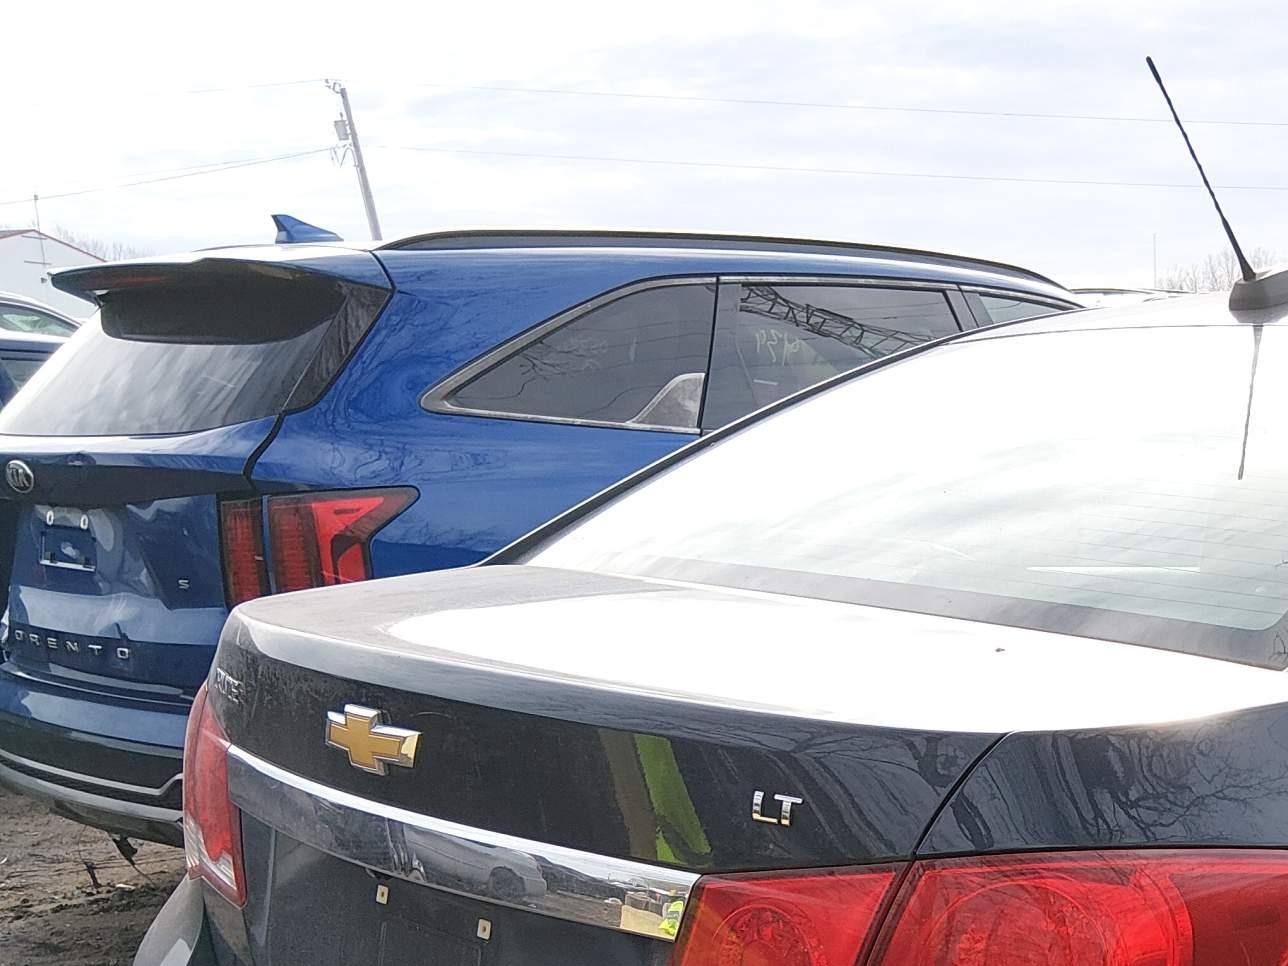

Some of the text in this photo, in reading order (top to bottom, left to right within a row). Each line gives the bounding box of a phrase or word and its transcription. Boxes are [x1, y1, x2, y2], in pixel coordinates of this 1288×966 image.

[178, 580, 190, 589] S
[14, 629, 130, 659] ORENTO
[752, 790, 803, 826] LT
